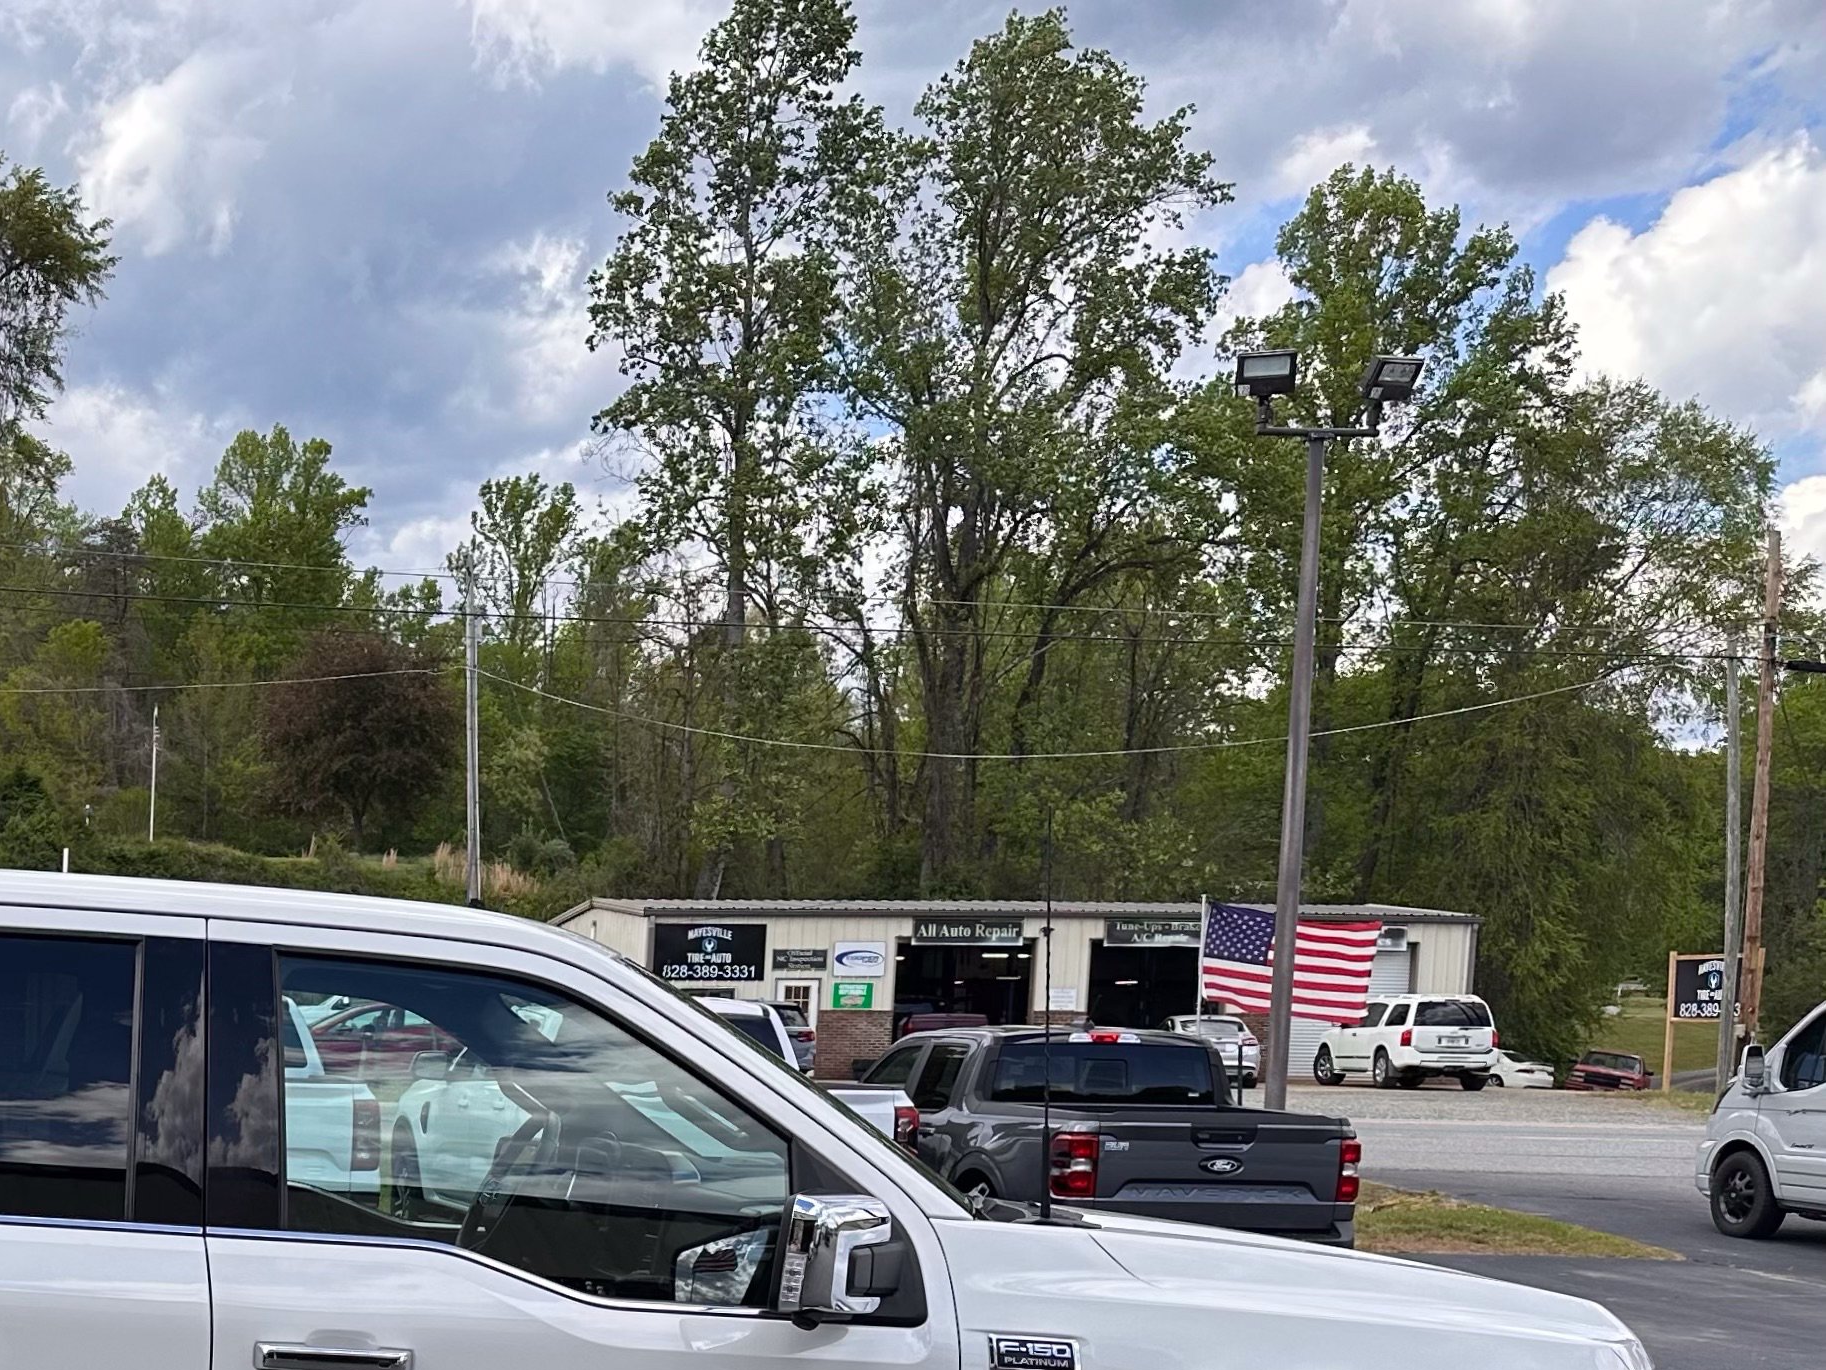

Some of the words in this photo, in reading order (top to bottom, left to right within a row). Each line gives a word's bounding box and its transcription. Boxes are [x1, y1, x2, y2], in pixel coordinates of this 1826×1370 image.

[916, 924, 936, 938] All
[939, 924, 972, 938] Auto
[974, 924, 1020, 941] Repair
[1116, 921, 1163, 933] Tune-Ups
[1130, 933, 1153, 943] A/C
[686, 952, 706, 964] TIRE
[710, 952, 733, 964] AUTO
[662, 964, 756, 979] 828-389-3331
[999, 1341, 1072, 1359] F-150
[1004, 1356, 1070, 1368] PLATINUM
